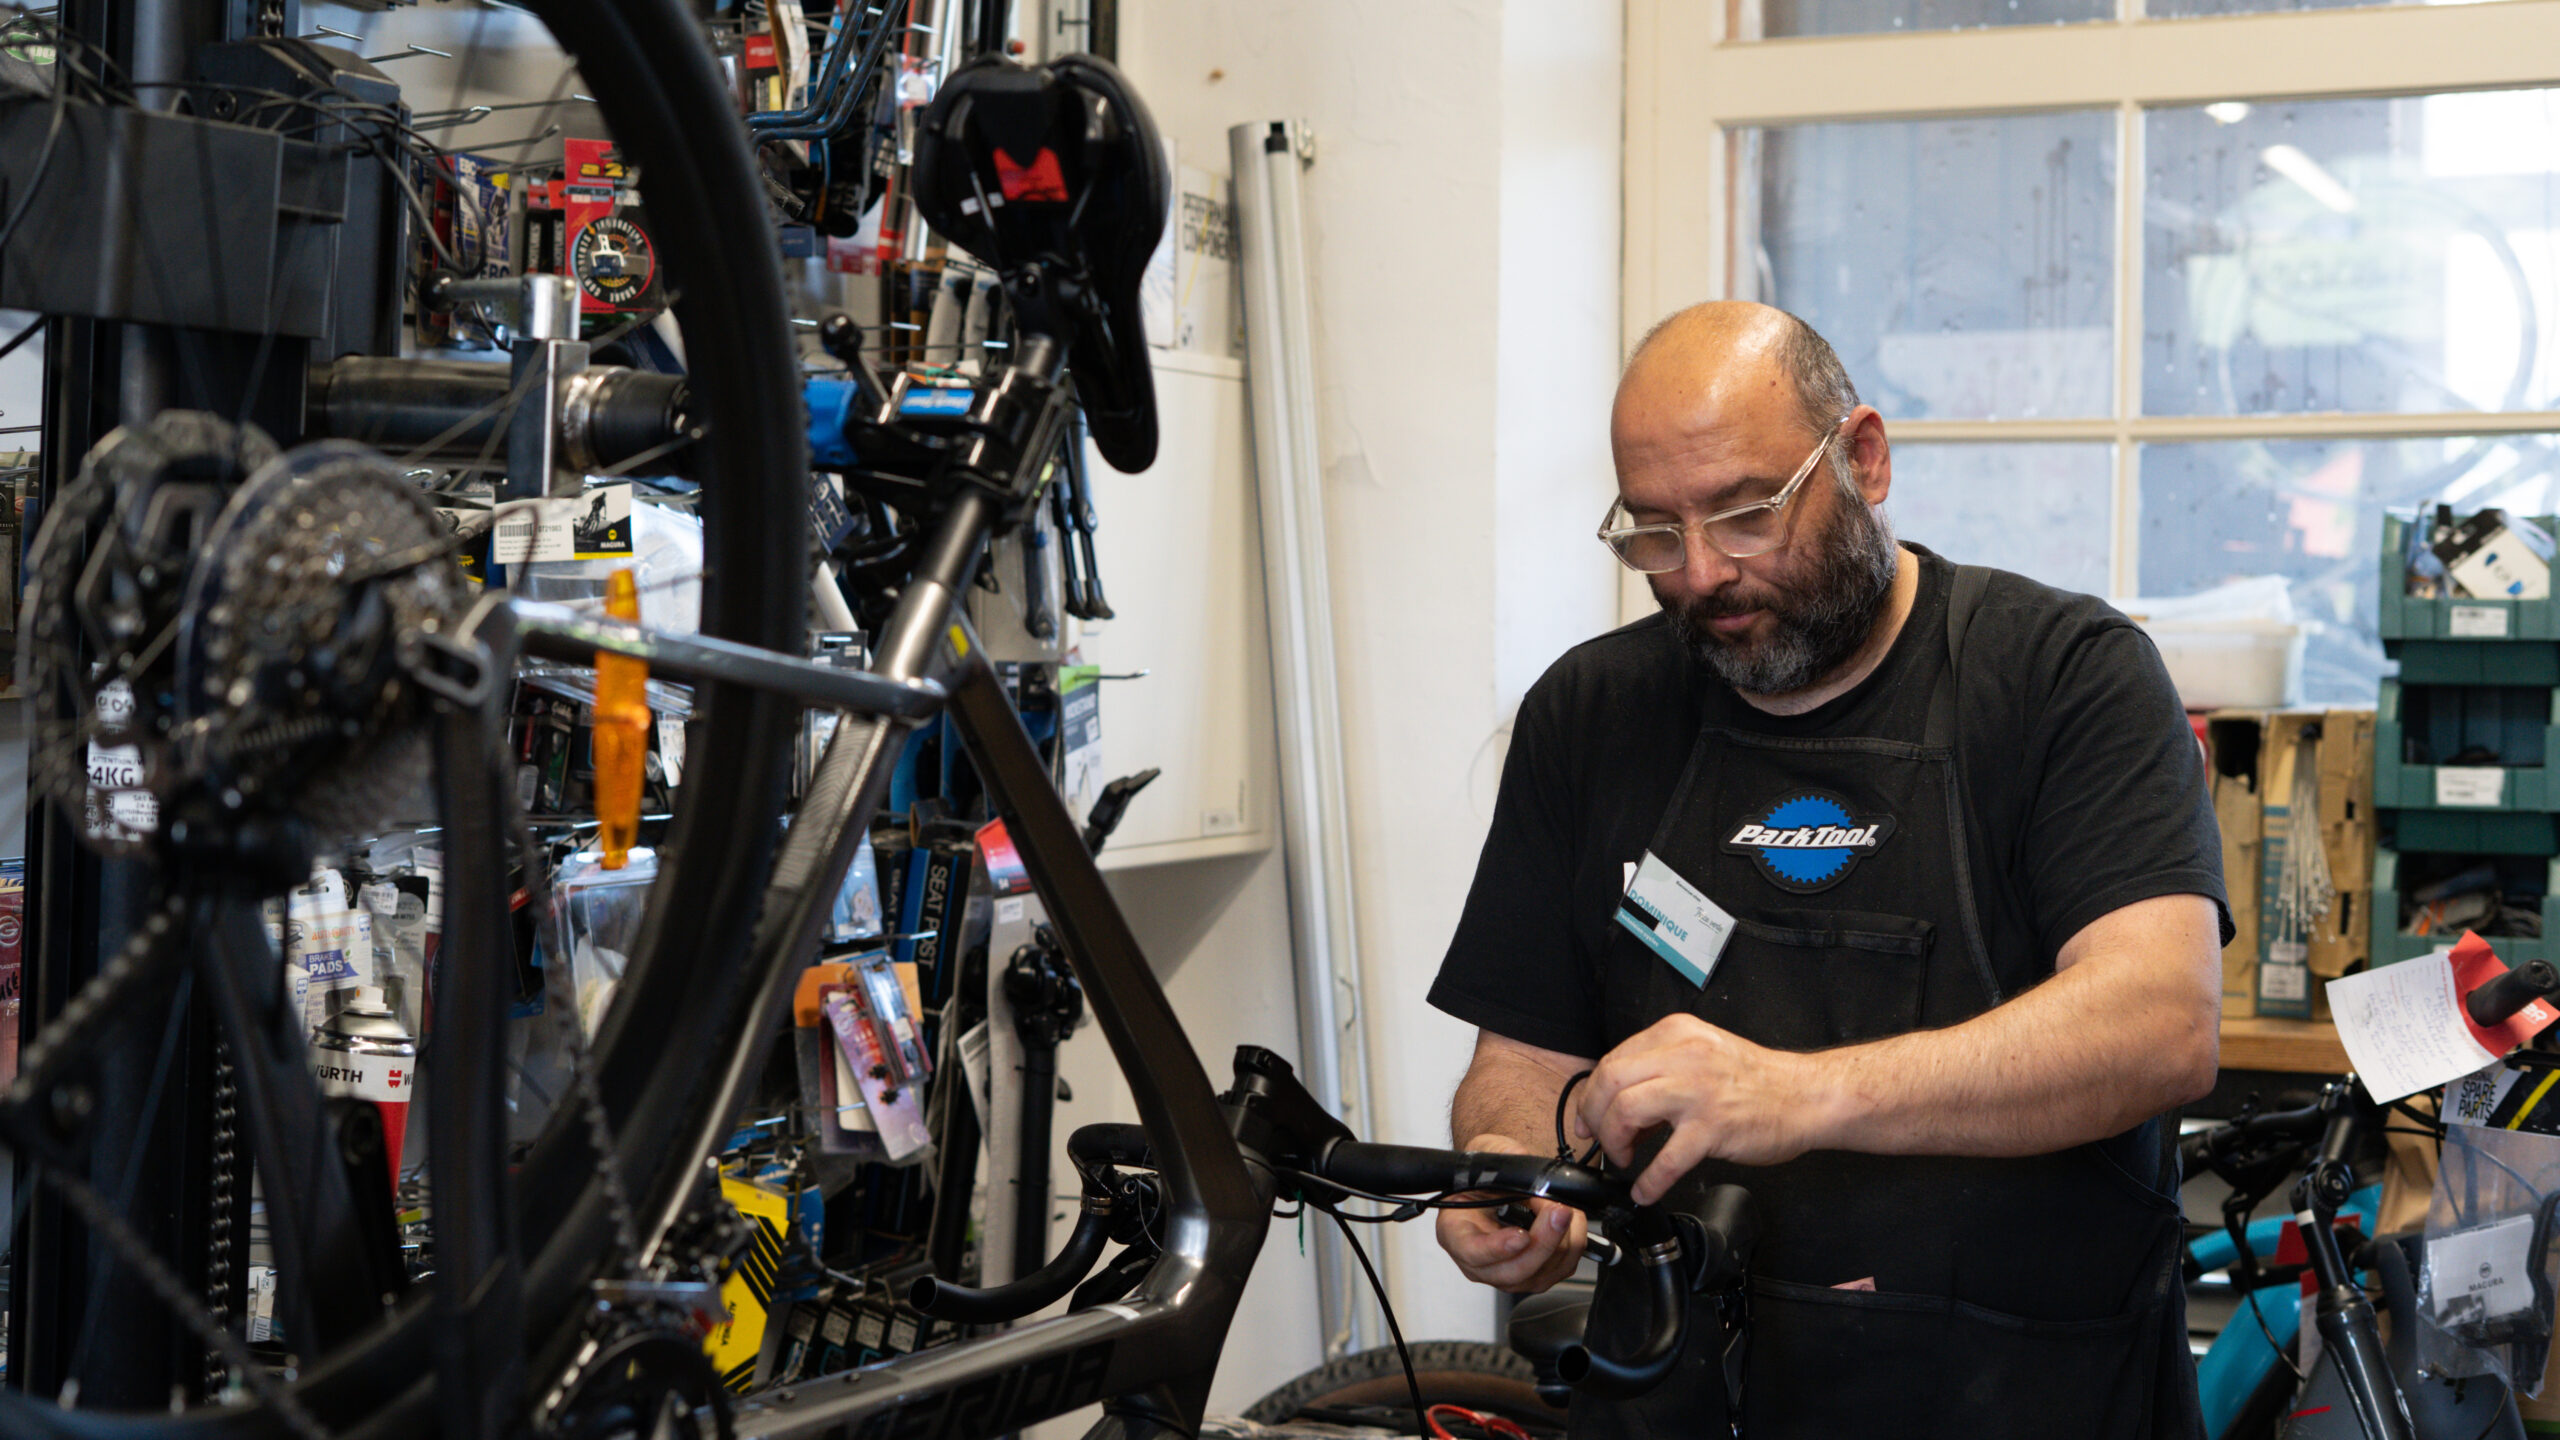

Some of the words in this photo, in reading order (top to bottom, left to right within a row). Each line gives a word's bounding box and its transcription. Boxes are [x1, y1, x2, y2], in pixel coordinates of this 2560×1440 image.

[923, 864, 949, 914] SEAT
[1628, 888, 1689, 942] DOMINIQUE
[309, 951, 334, 963] BRAKE
[309, 959, 344, 976] PADS
[315, 1065, 363, 1083] ÜRTH
[2461, 1080, 2497, 1102] SPARE
[2457, 1099, 2494, 1123] PARTS
[2469, 1277, 2505, 1292] MAGURA
